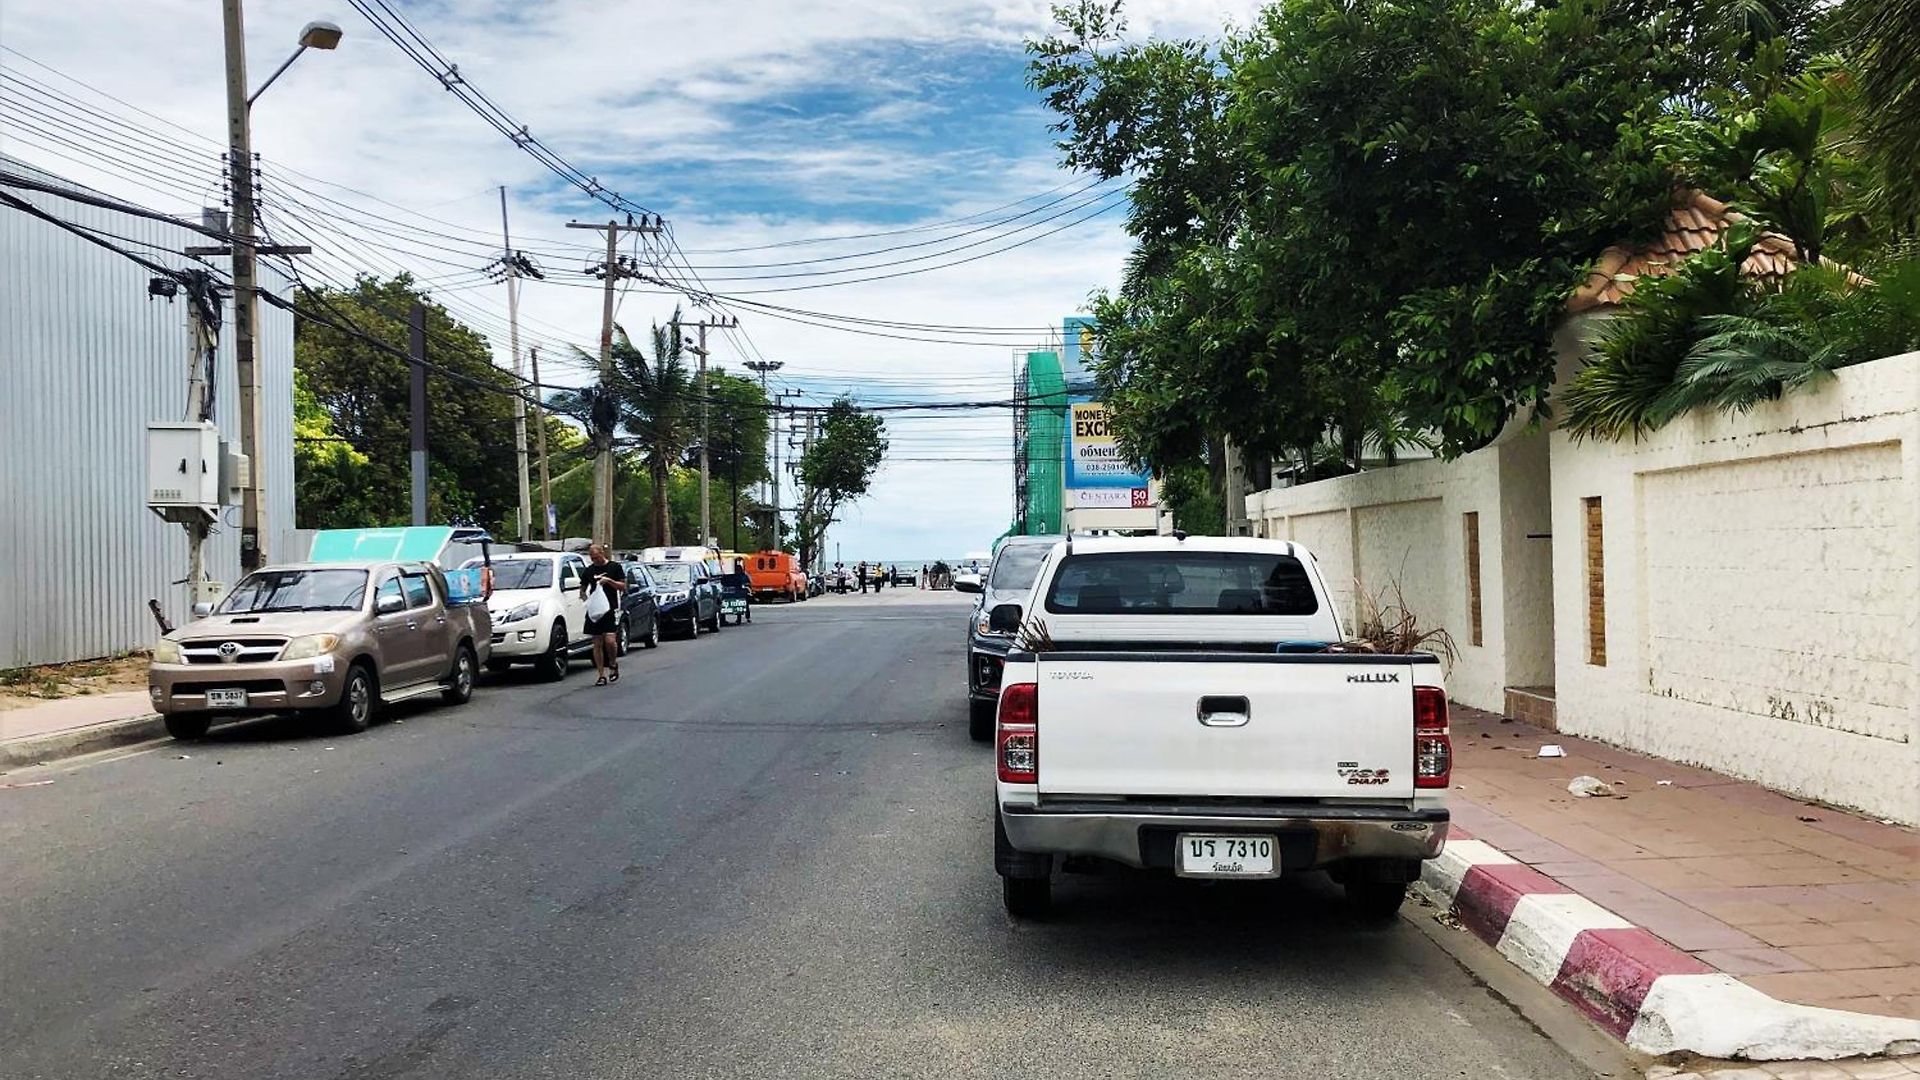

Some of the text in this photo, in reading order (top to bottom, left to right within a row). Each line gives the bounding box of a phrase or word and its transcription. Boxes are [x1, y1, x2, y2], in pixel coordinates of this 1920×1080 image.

[1075, 410, 1110, 420] MONEY
[1076, 421, 1117, 437] EXCH
[1133, 490, 1146, 500] 50
[1050, 671, 1095, 680] TOYOTA
[1347, 673, 1399, 683] HILUX
[1225, 840, 1270, 858] 7310
